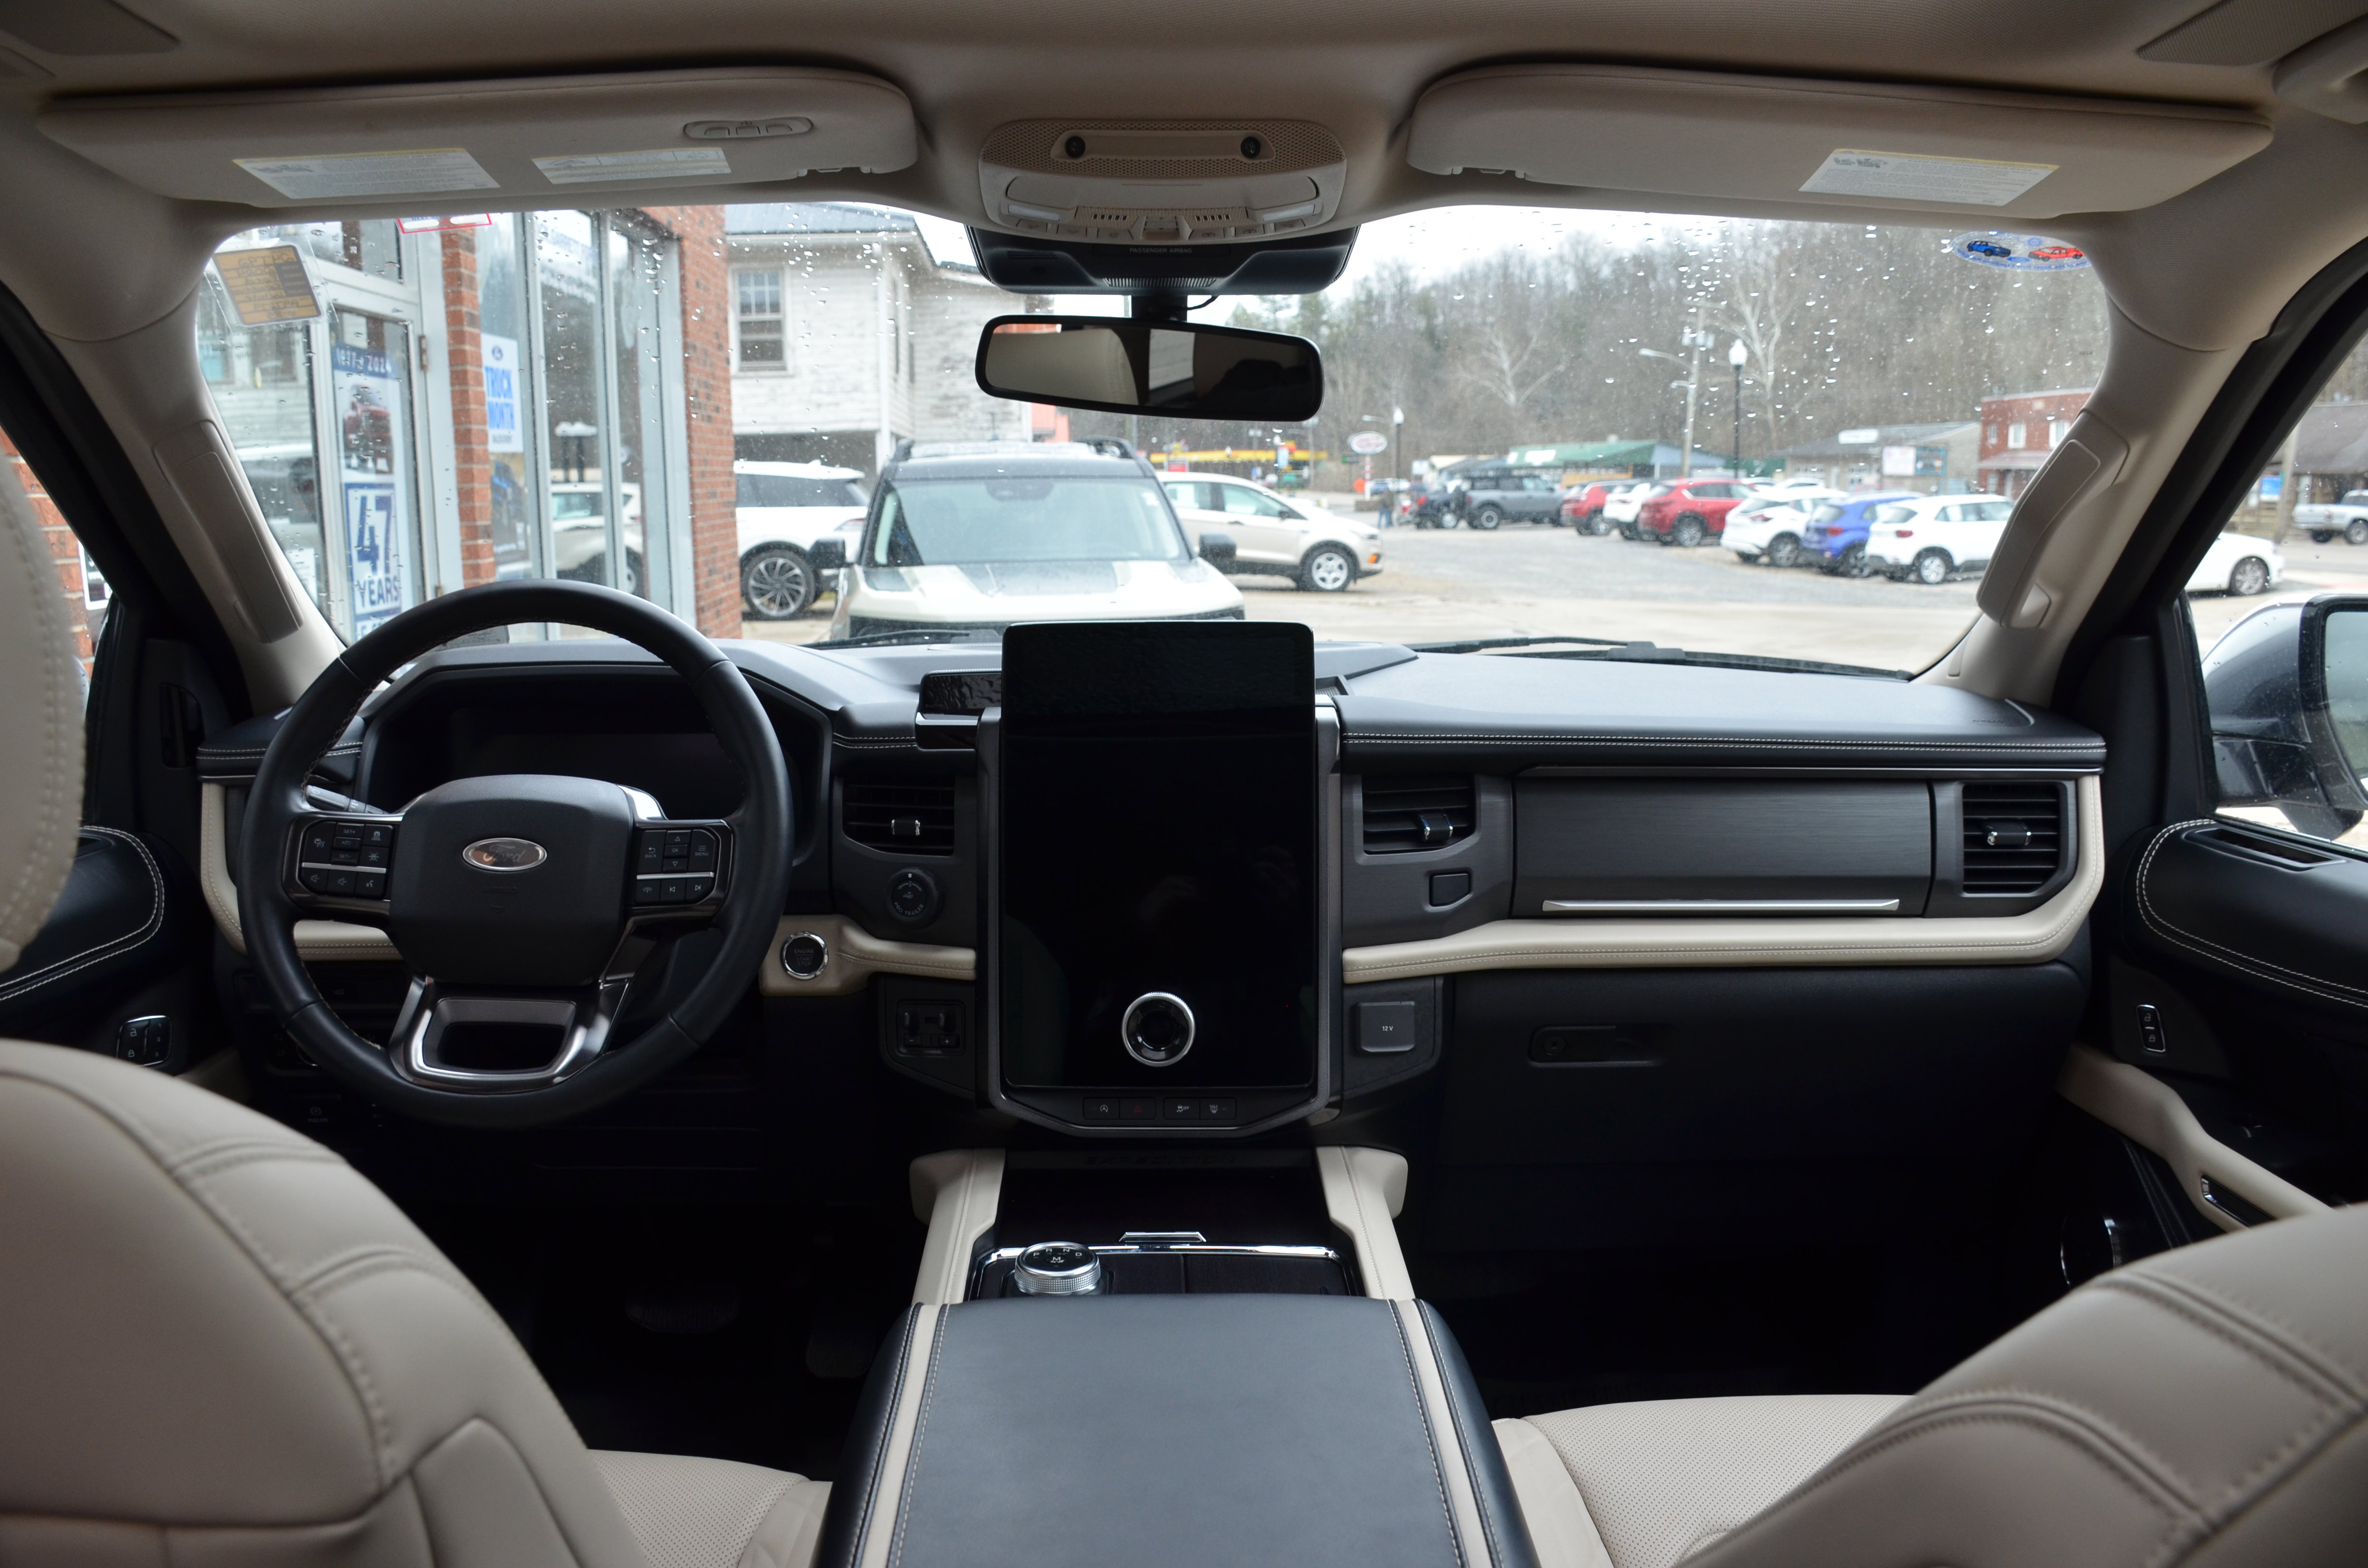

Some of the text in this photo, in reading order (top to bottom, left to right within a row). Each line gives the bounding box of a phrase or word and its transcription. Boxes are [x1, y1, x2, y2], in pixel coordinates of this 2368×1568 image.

[358, 494, 393, 575] 47
[357, 575, 400, 608] YEARS
[489, 844, 526, 863] Ford
[894, 902, 925, 916] PRO TRAILER
